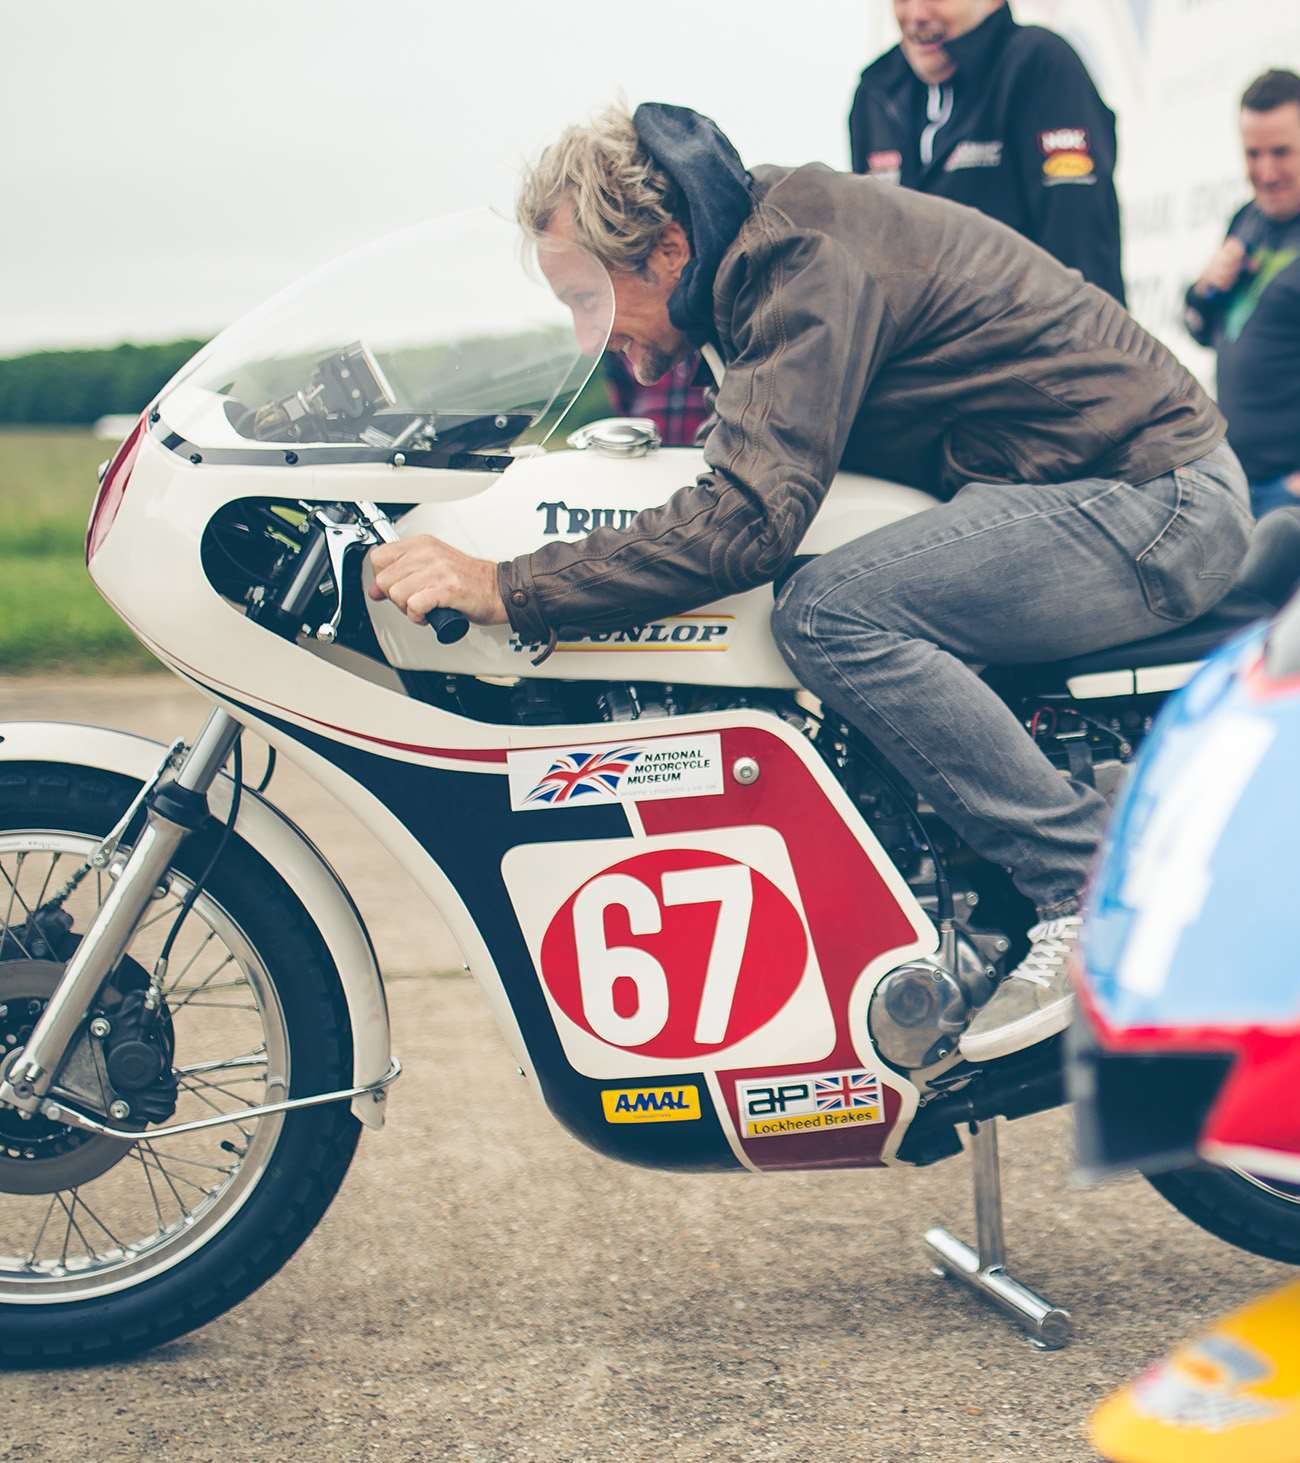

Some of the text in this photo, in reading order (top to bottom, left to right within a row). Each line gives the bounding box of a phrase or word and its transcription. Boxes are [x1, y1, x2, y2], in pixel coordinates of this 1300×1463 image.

[536, 500, 638, 534] TRIU
[634, 759, 711, 774] MOTORCYCLE
[644, 749, 704, 762] NATIONAL
[627, 772, 681, 785] MUSEUM
[572, 864, 754, 1047] 67
[615, 1090, 691, 1112] AMAL
[753, 1111, 873, 1136] Lockheed Brakes
